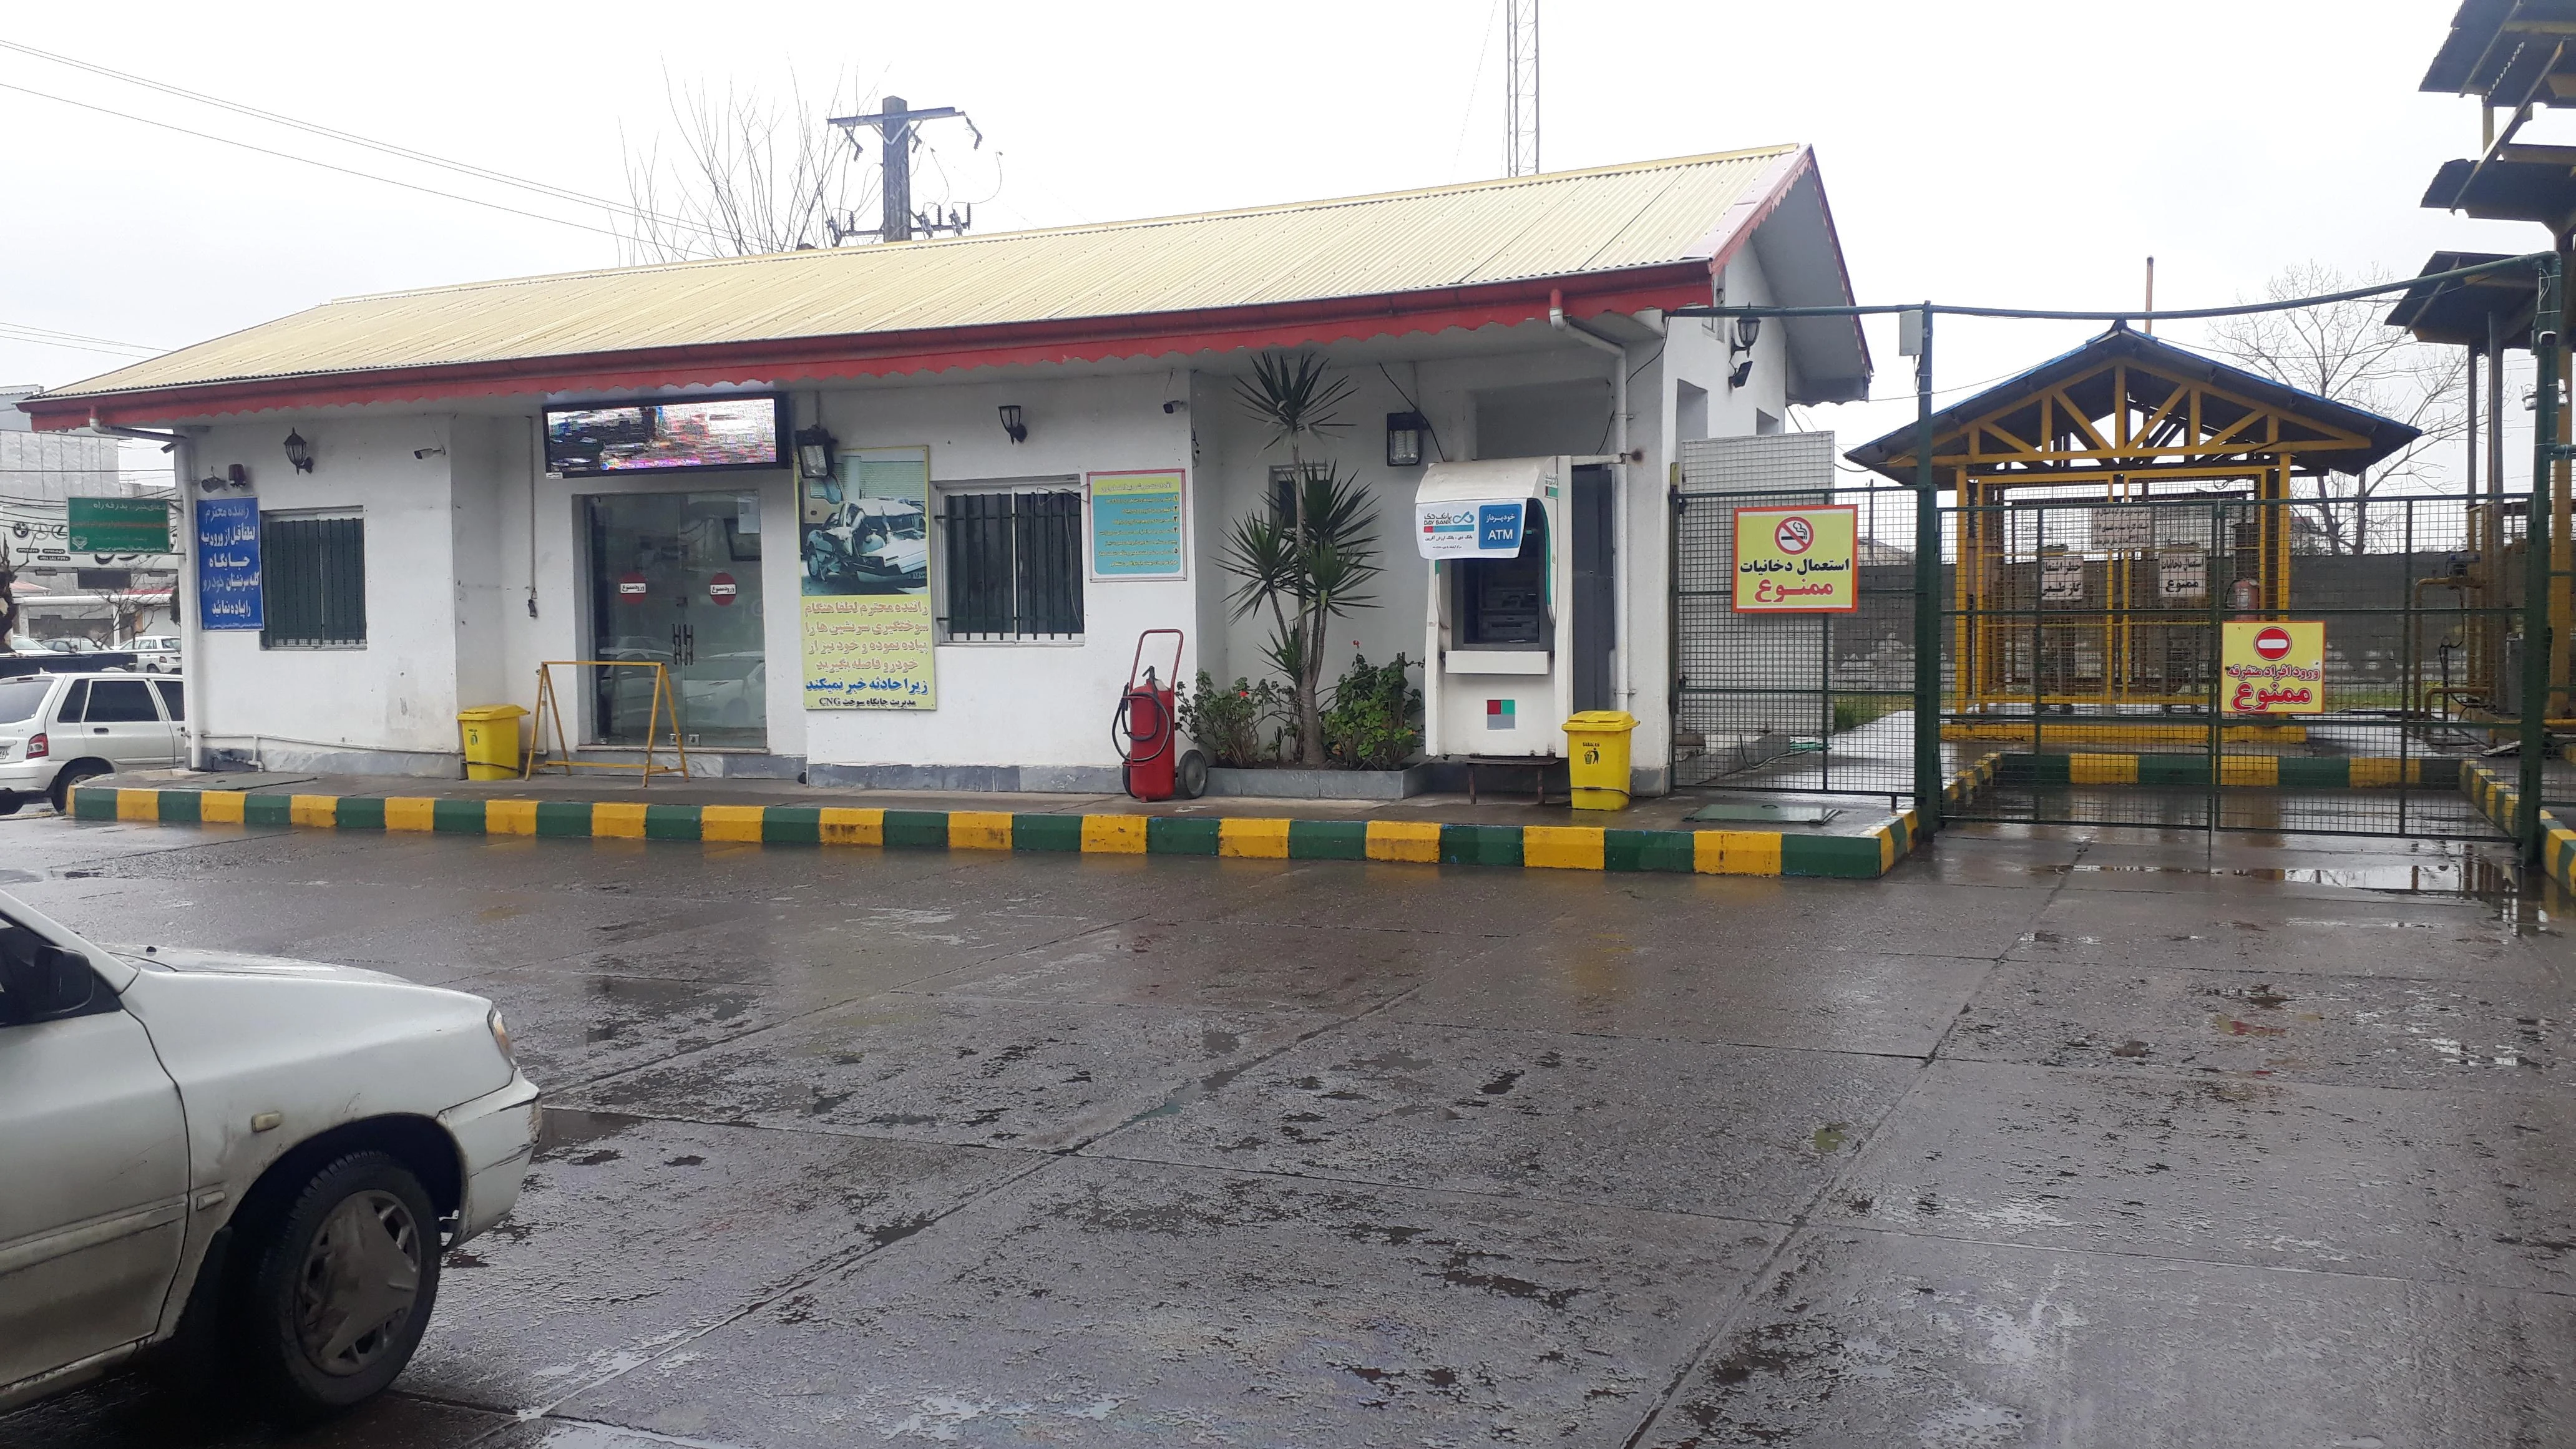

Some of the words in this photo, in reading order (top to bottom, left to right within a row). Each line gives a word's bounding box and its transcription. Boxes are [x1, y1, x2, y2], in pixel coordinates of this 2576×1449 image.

[94, 501, 104, 510] راه
[205, 505, 227, 524] محترم
[1486, 513, 1516, 524] خودپرداز
[201, 531, 210, 545] به
[210, 533, 223, 547] ورود
[224, 527, 230, 546] از
[1488, 529, 1513, 540] ATM
[209, 552, 250, 571] جایگاه
[1740, 559, 1793, 575] دخانیات
[1797, 558, 1850, 575] استعمال
[203, 575, 225, 593] خودرو
[1754, 578, 1833, 603] ممنوع
[2166, 579, 2199, 592] ممنوع
[231, 599, 245, 618] پیاده
[246, 599, 251, 617] را
[804, 602, 835, 617] هنگام
[835, 601, 858, 613] لطفا
[860, 602, 893, 617] محترم
[894, 600, 929, 616] راننده
[804, 622, 816, 636] را
[816, 622, 828, 632] ها
[830, 620, 870, 635] سرنشین
[872, 620, 929, 635] سوختگیری
[808, 639, 818, 654] از
[837, 640, 859, 653] خود
[861, 643, 868, 653] و
[869, 641, 900, 654] نموده
[901, 639, 929, 654] پیاده
[816, 658, 850, 673] بگیرید
[852, 658, 881, 670] فاصله
[884, 658, 919, 673] خودرو
[2227, 663, 2263, 681] متفرقه
[2263, 664, 2291, 681] افراد
[2293, 665, 2321, 681] ورود
[806, 676, 844, 694] نمیکند
[846, 677, 867, 695] خبر
[869, 676, 902, 691] حادثه
[904, 678, 929, 695] زیرا
[819, 697, 841, 706] CNG
[842, 698, 865, 708] سوخت
[866, 697, 888, 708] جایگاه
[889, 698, 916, 708] مدیریت
[2230, 681, 2312, 712] ممنوع
